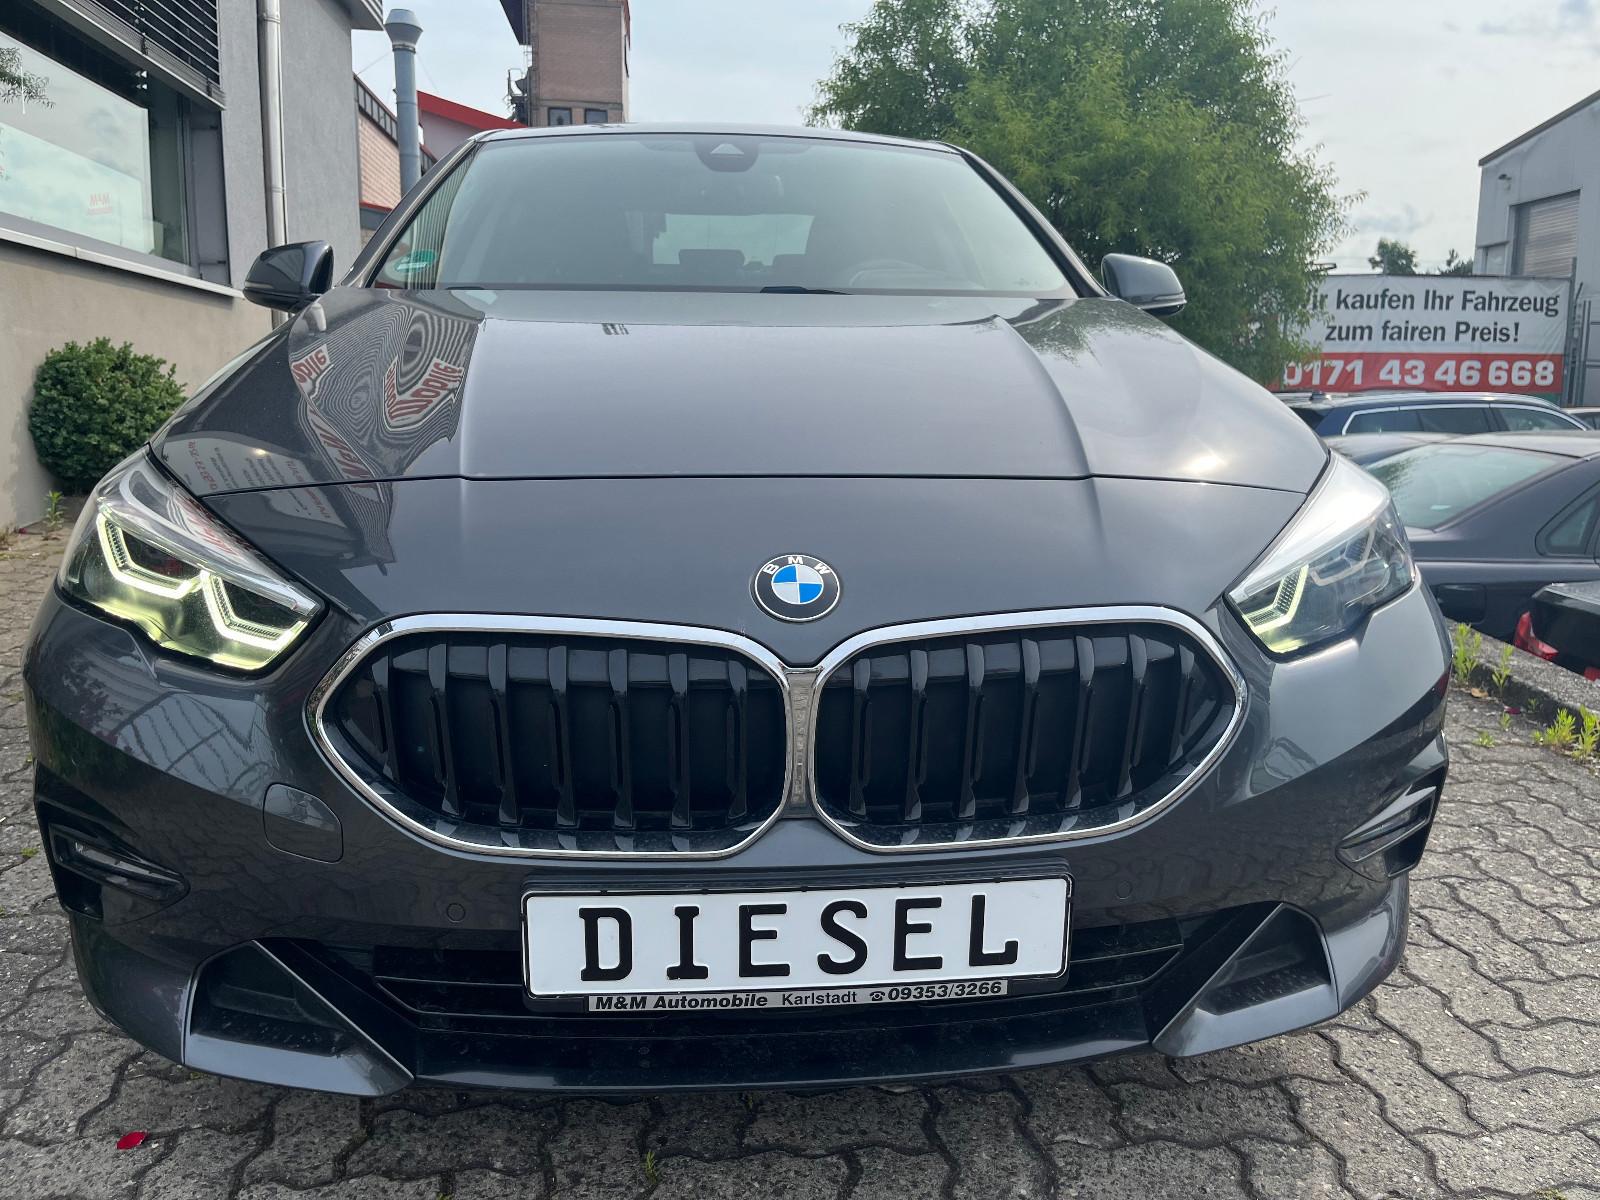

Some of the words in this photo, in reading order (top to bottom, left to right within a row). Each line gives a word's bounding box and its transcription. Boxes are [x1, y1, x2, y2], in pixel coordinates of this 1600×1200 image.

[1336, 288, 1415, 310] kaufen
[1423, 289, 1454, 311] Ihr
[1461, 290, 1560, 318] Fahrzeug
[1325, 324, 1373, 341] zum
[1381, 320, 1446, 341] fairen
[1454, 321, 1520, 342] Preis!
[1283, 359, 1364, 386] 0171
[1379, 359, 1426, 386] 43
[1434, 360, 1482, 386] 46
[1488, 360, 1555, 387] 668
[762, 556, 831, 575] BMW
[578, 894, 1018, 982] DIESEL
[595, 996, 648, 1010] M&M
[653, 993, 768, 1009] Automobile
[782, 991, 857, 1006] Karlstadt
[887, 981, 1003, 1001] 09353/3266
